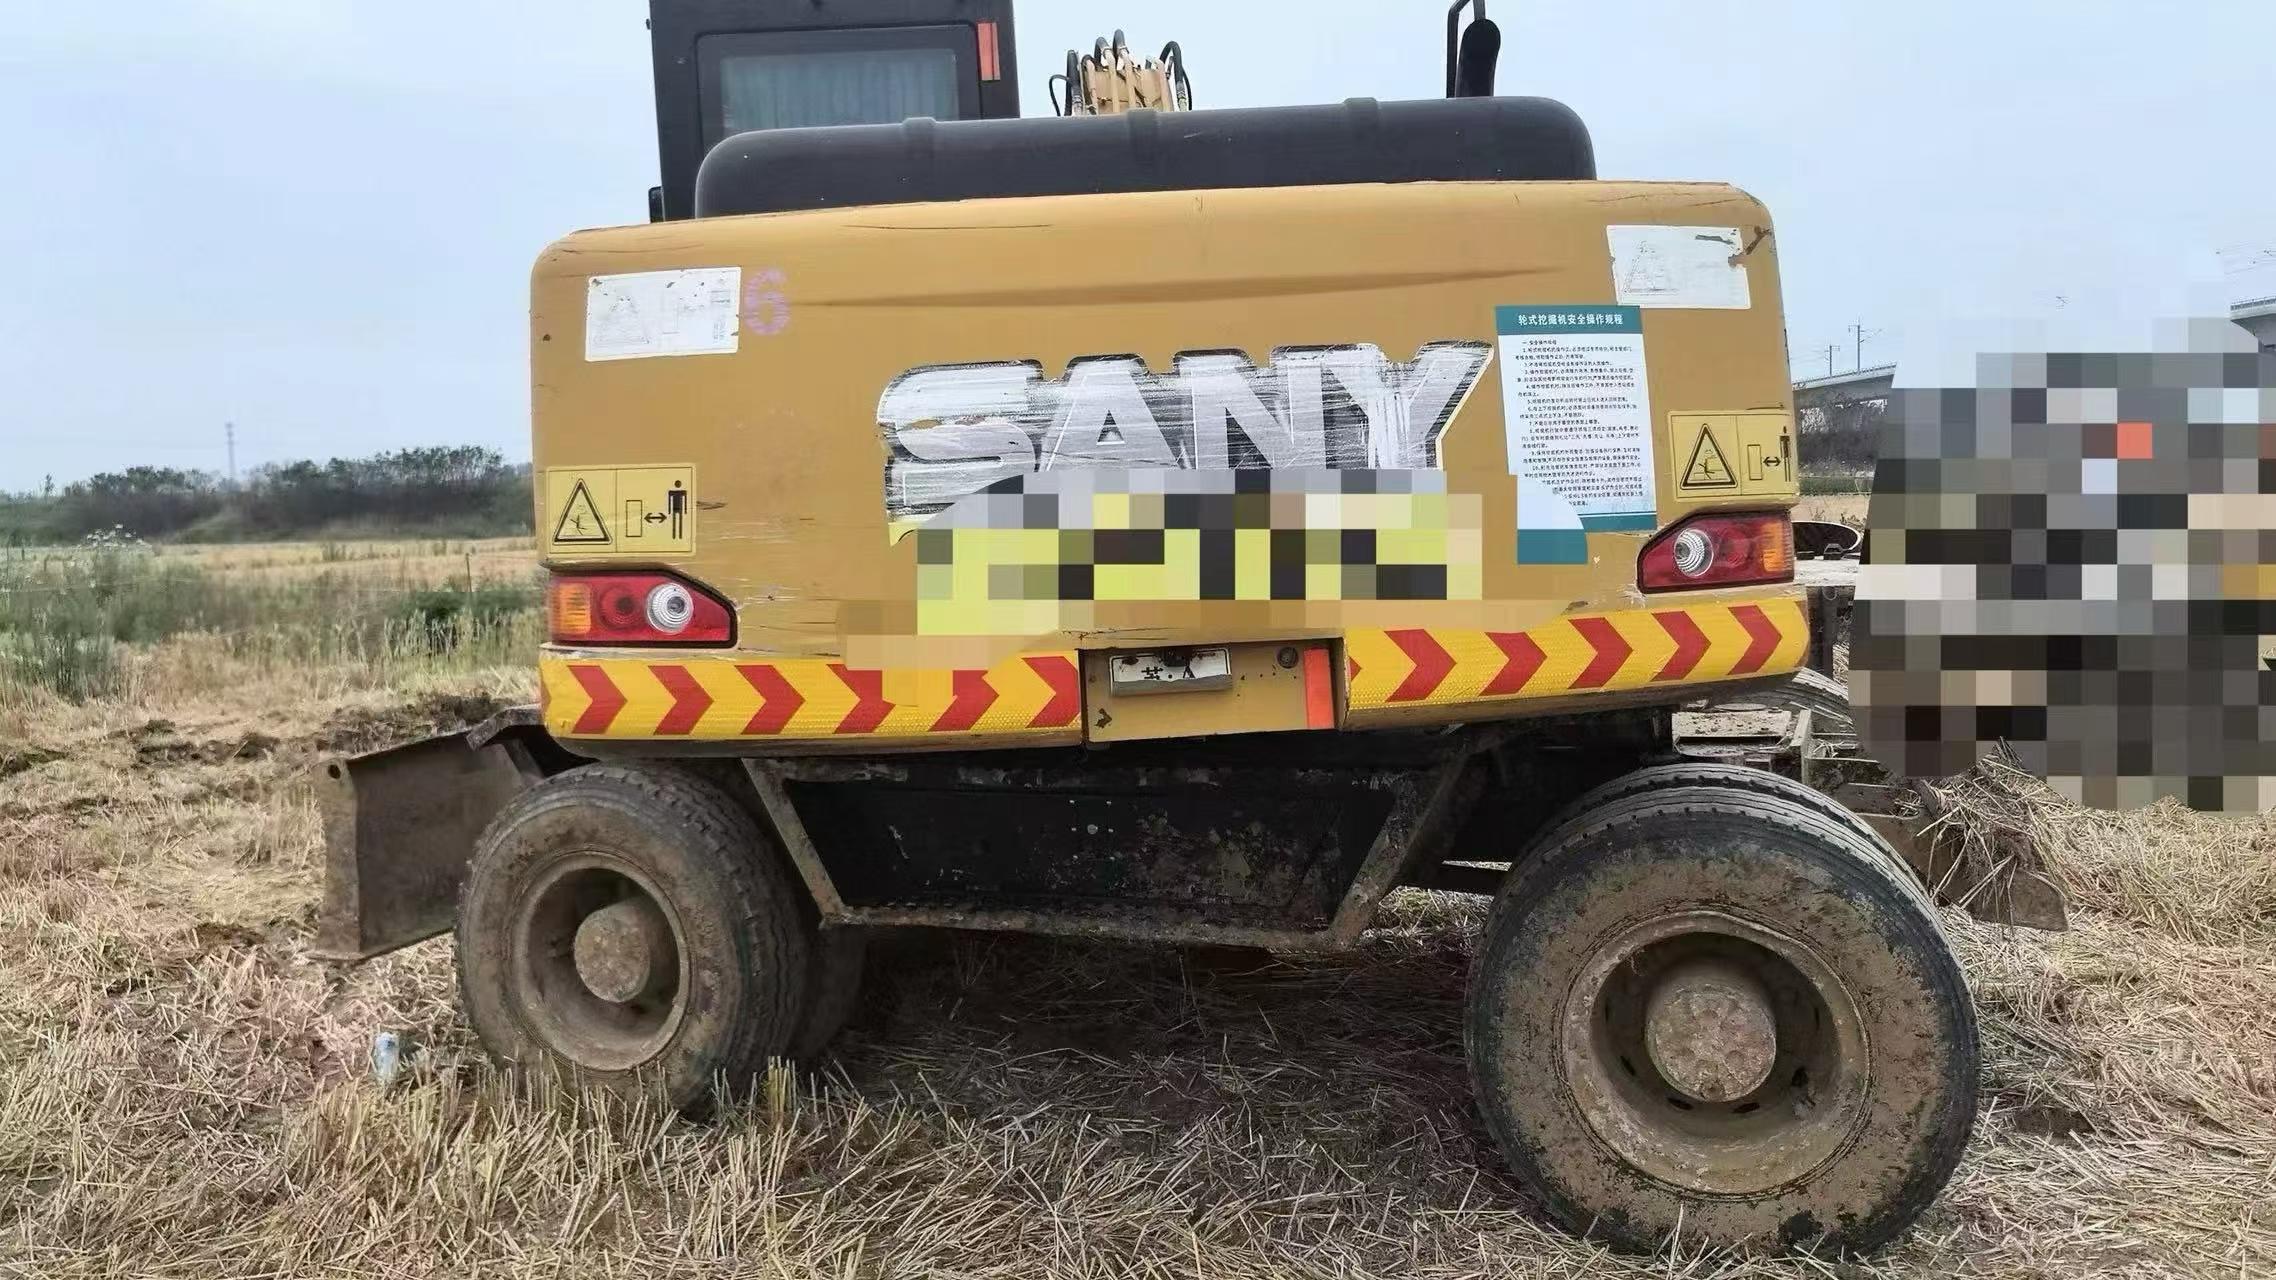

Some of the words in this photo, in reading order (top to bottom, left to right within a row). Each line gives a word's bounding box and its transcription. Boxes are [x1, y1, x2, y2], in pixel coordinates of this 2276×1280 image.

[743, 267, 791, 335] 6
[1518, 313, 1623, 326] 轮式挖掘机安全操作规程
[878, 341, 1494, 514] SANY
